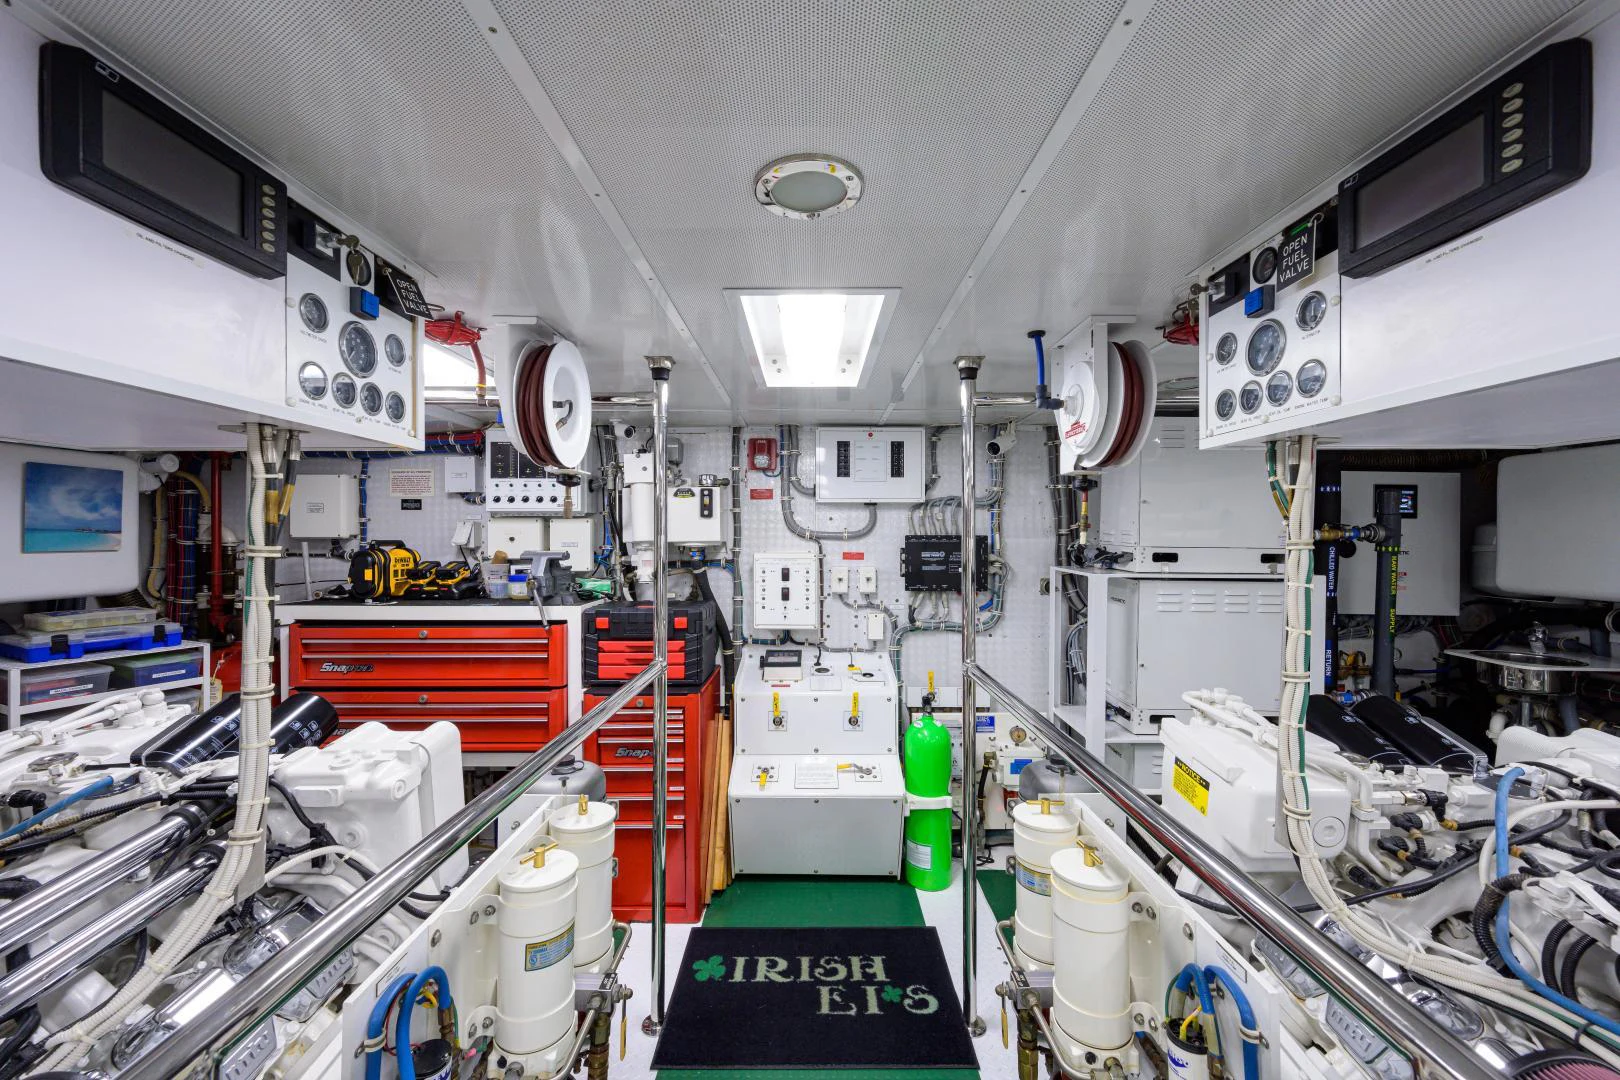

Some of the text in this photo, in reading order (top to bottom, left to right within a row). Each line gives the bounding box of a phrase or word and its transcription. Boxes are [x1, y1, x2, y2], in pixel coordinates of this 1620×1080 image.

[1282, 233, 1308, 256] OPEN
[1282, 248, 1307, 269] FUEL
[1279, 258, 1310, 283] VALVE
[396, 279, 418, 293] OPEN
[401, 289, 422, 303] FUEL
[404, 299, 429, 314] VALVE
[1328, 546, 1336, 590] CHILLED WATER
[1390, 569, 1398, 595] WATER
[728, 955, 890, 983] IRISH
